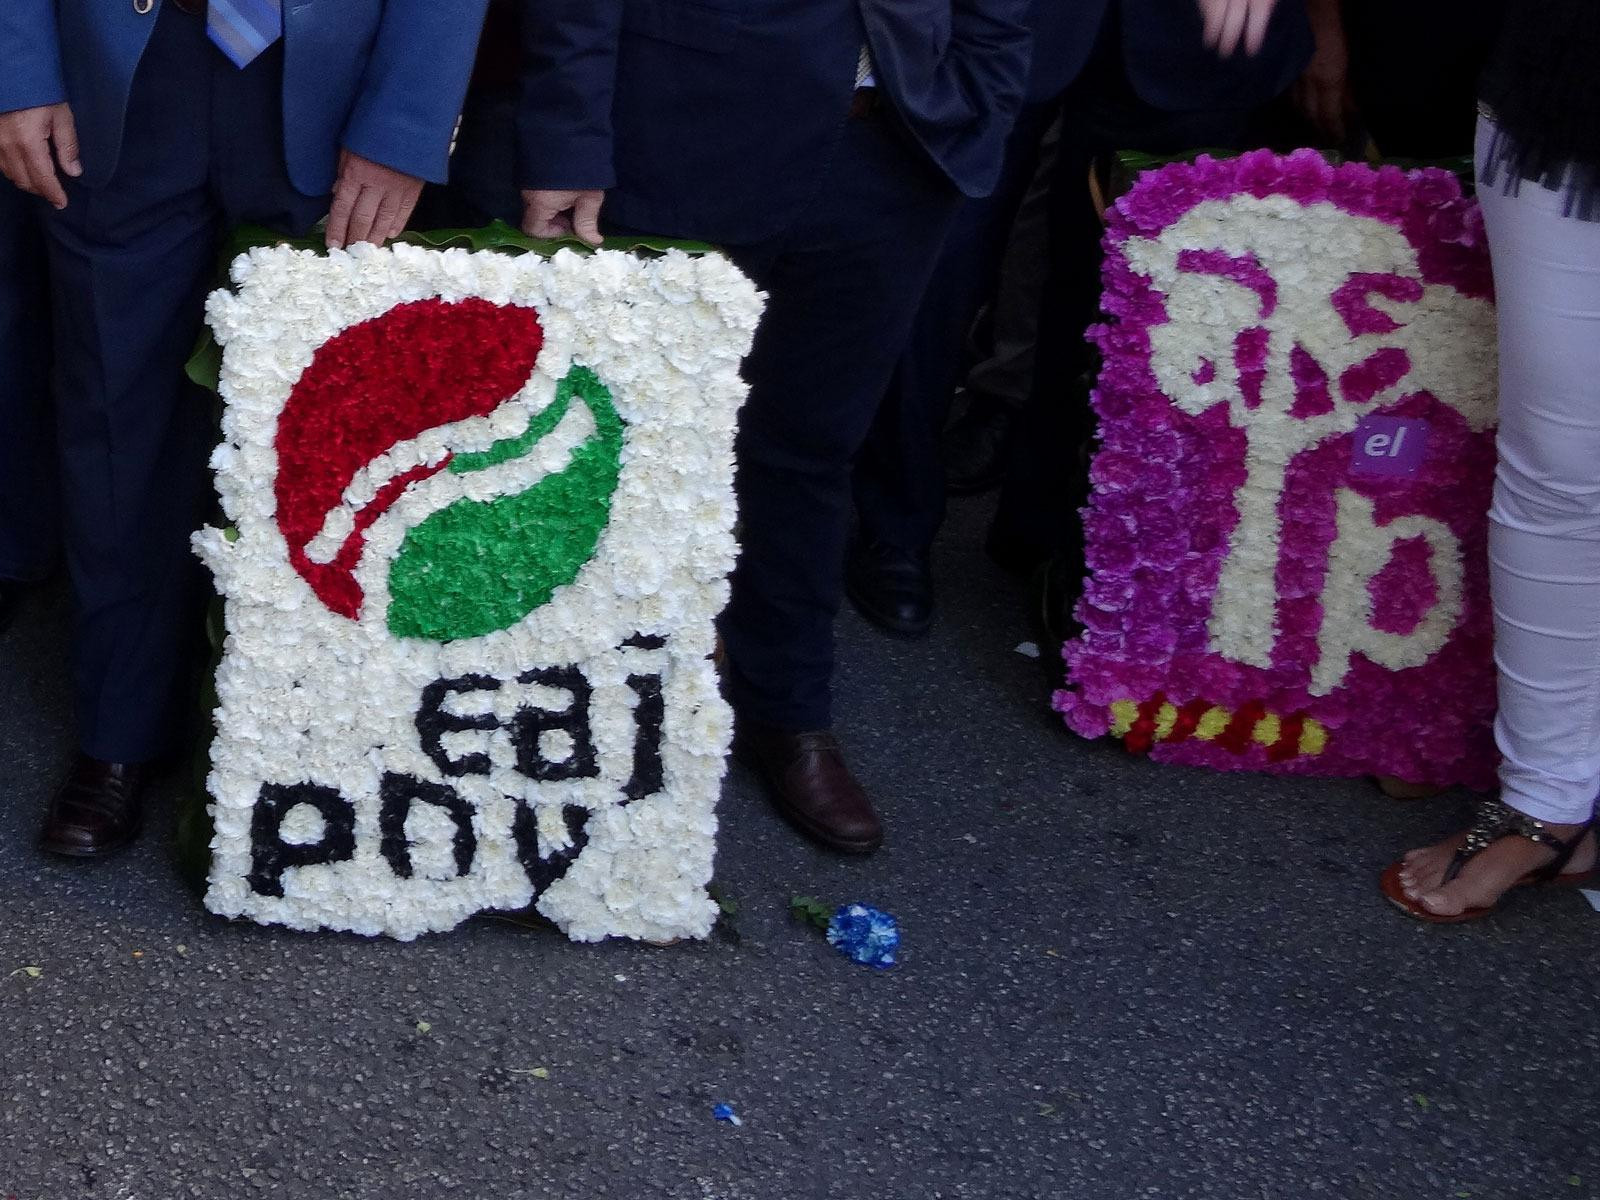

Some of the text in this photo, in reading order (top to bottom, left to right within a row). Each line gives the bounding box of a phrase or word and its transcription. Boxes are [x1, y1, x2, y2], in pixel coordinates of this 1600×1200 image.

[1364, 426, 1408, 457] el
[414, 631, 672, 806] eaj
[246, 770, 594, 904] pnv
